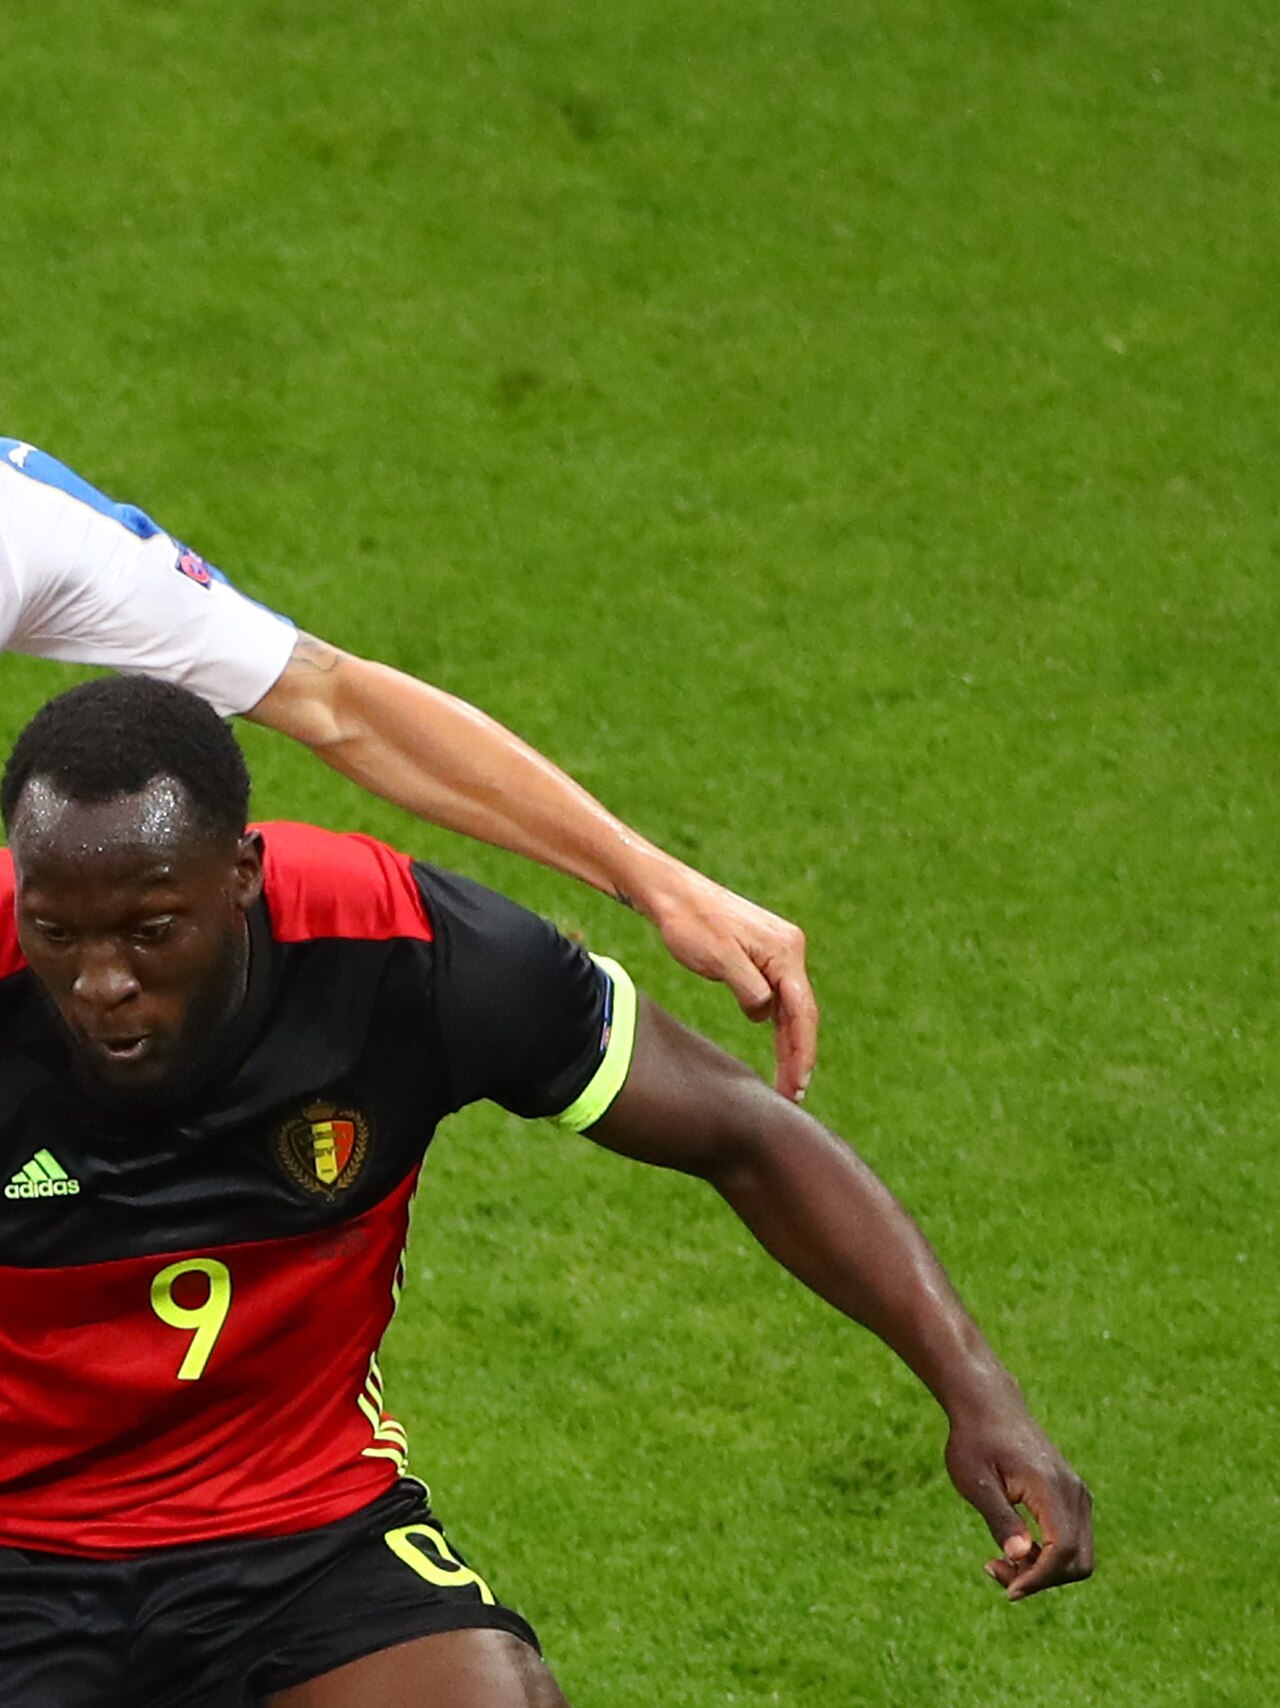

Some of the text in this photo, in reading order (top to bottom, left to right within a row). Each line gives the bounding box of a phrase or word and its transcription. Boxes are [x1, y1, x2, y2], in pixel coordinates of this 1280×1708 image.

[4, 1180, 81, 1199] adidas
[150, 1257, 232, 1380] 9
[384, 1523, 496, 1606] 9
